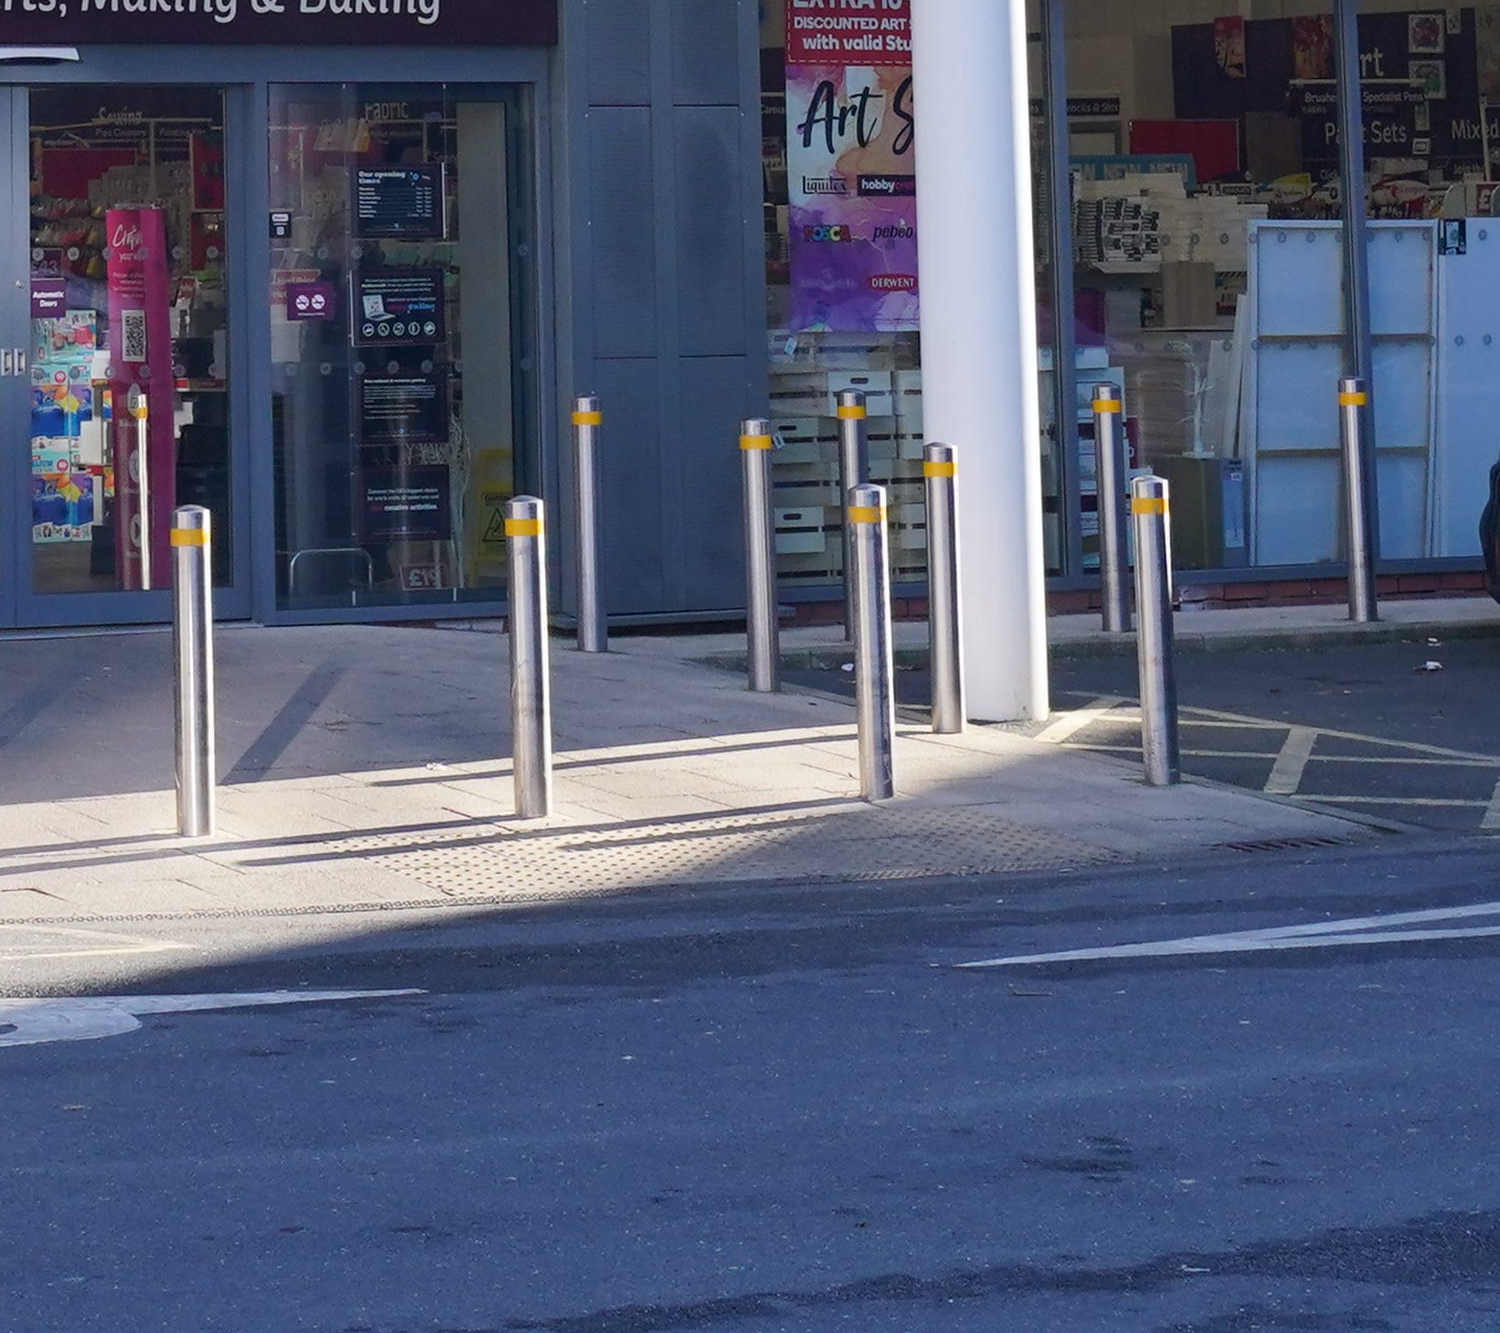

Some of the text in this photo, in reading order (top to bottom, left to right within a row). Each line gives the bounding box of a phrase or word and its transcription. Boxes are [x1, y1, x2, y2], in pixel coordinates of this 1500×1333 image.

[794, 17, 907, 30] DISCOUNTED ART
[802, 33, 840, 50] with
[843, 34, 882, 51] valid
[1360, 46, 1384, 77] rt
[1304, 91, 1337, 103] Brushe
[797, 80, 884, 154] Art
[1370, 121, 1408, 144] Sets
[871, 277, 915, 288] DERWENT
[32, 290, 65, 299] Automatic
[39, 299, 59, 308] Doors
